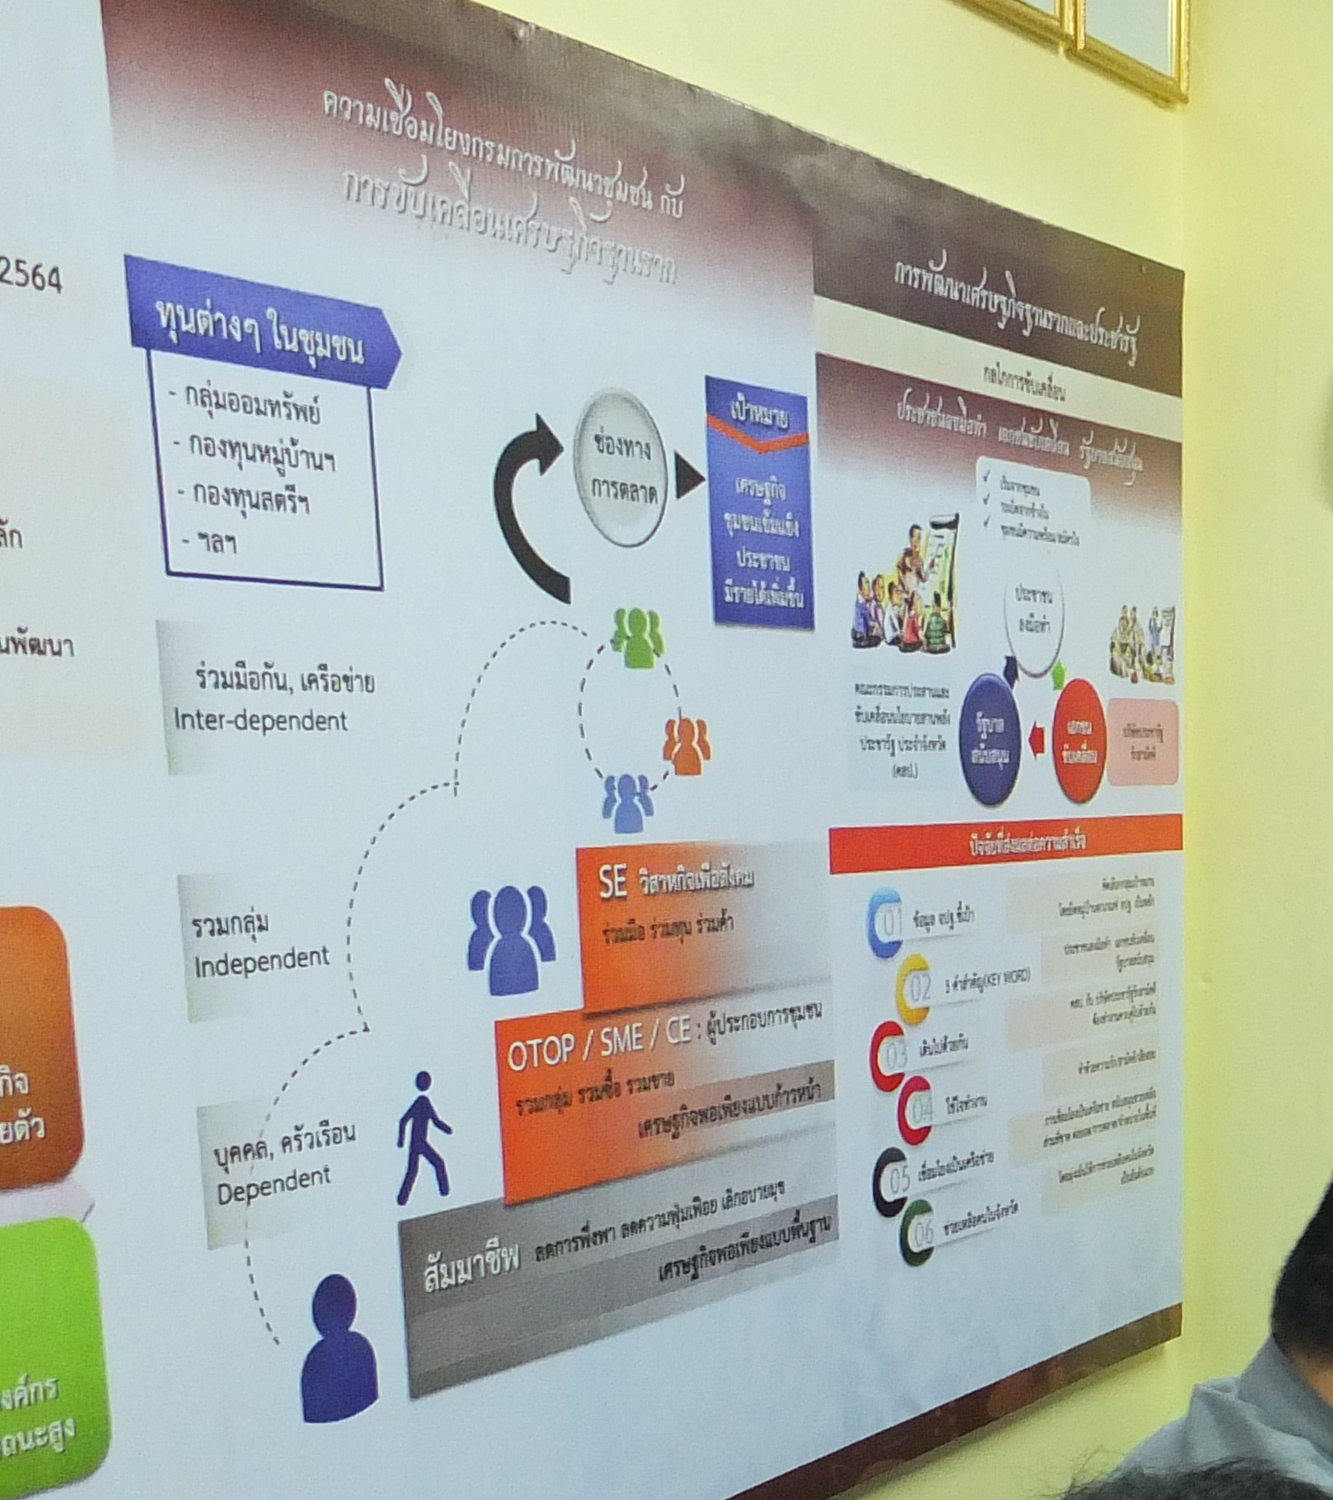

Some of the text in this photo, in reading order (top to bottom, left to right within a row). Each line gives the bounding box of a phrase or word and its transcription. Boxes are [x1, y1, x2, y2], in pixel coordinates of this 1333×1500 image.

[322, 76, 686, 224] ความเชื่อมโยงกรมการพัฒนาชุมชน กับ
[156, 294, 366, 369] ทุนต่างๆ ในชุมชน
[184, 377, 322, 426] กลุ่มออมทรัพย์
[188, 431, 336, 478] กองทุนหมู่บ้านฯ
[590, 475, 660, 506] การตลาด
[195, 660, 377, 697] ร่วมมือกัน, เครือข่าย
[173, 706, 349, 736] Inter-dependent
[598, 862, 629, 900] SE
[191, 906, 270, 943] รวมกลุ่ม
[194, 945, 331, 980] Independent
[506, 1032, 577, 1073] OTOP
[600, 1021, 645, 1059] SME
[665, 1013, 693, 1045] CE
[279, 1122, 358, 1157] ครัวเรือน
[216, 1165, 332, 1208] Dependent
[422, 1237, 522, 1293] สัมมาชีพ
